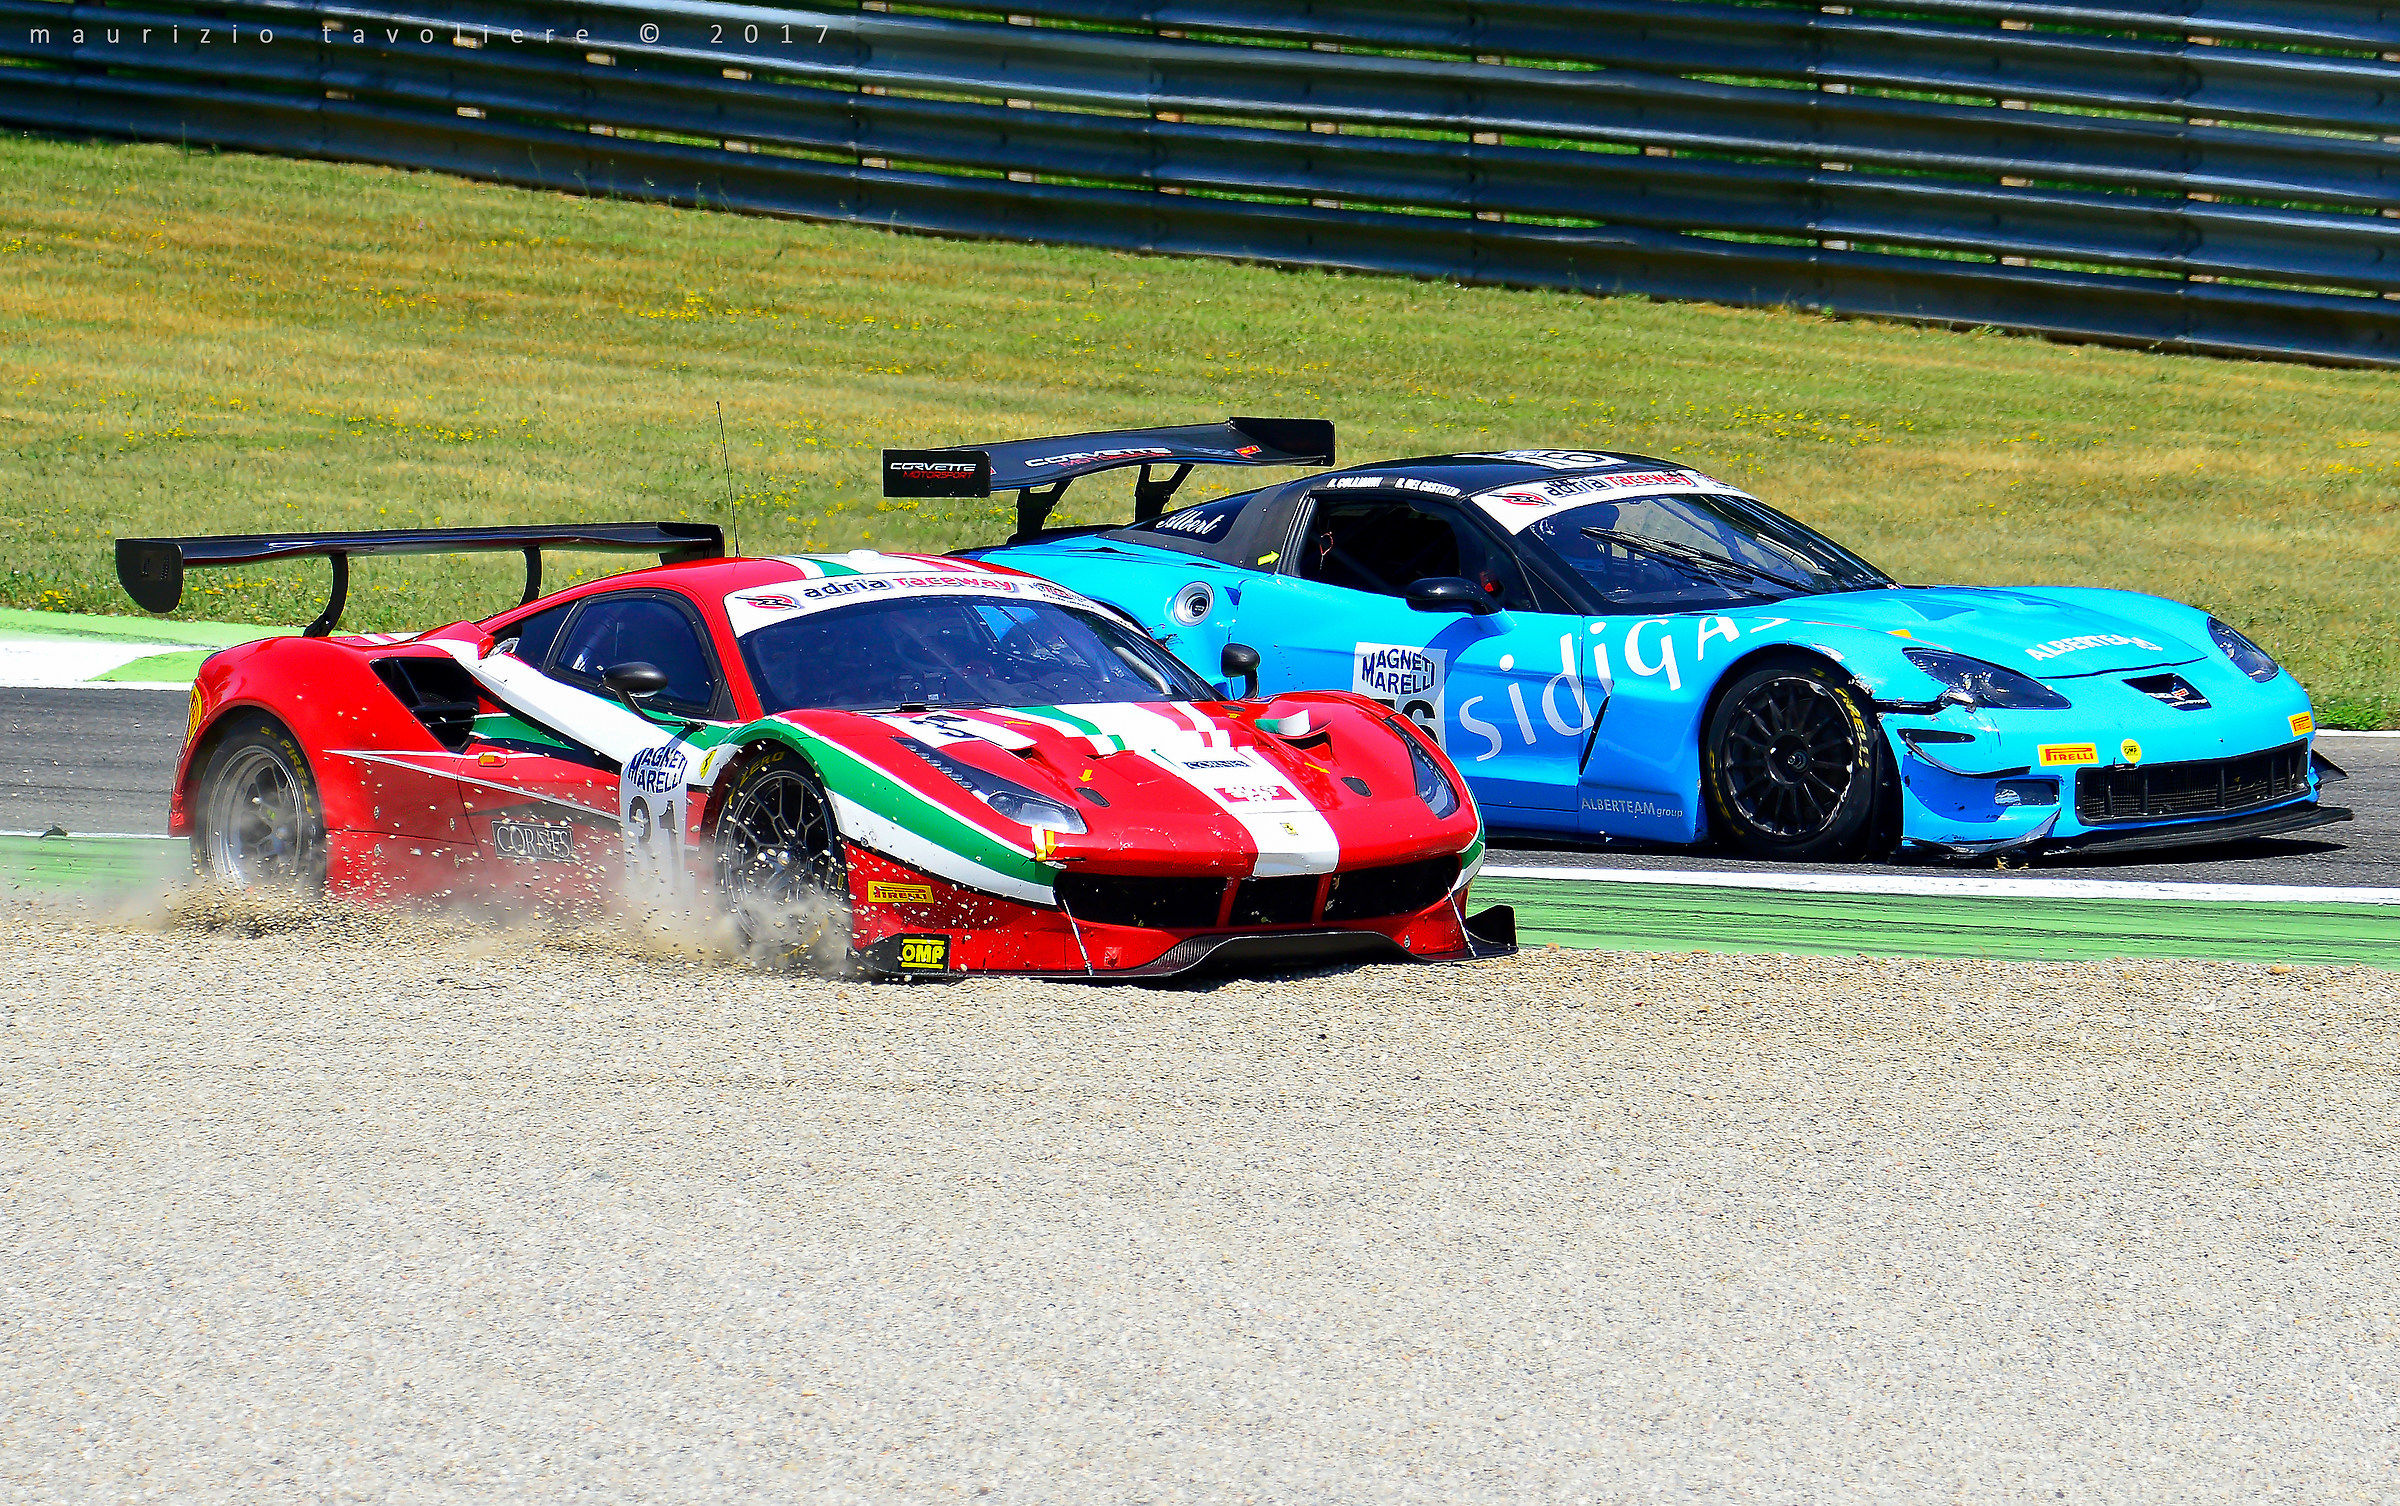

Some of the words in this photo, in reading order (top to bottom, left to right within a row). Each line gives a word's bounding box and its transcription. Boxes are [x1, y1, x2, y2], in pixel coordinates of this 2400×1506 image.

[890, 462, 976, 472] CORVETTE
[1025, 447, 1173, 467] CORVETTE
[903, 470, 974, 480] MOTORSPORT
[1156, 509, 1225, 535] Albert
[803, 577, 890, 599] adria
[892, 576, 1014, 592] raceway
[1361, 648, 1436, 677] MAGNETI
[1361, 668, 1436, 695] MARELLI
[1371, 697, 1441, 747] 6
[627, 746, 688, 778] MAGNETI
[2044, 747, 2095, 762] PIRELLI
[627, 765, 688, 794] MARELLI
[1581, 797, 1656, 816] ALBERTEAM
[1656, 806, 1683, 819] group
[496, 825, 571, 858] CORNES
[873, 885, 928, 899] PIRELLI
[901, 943, 945, 964] OMP
